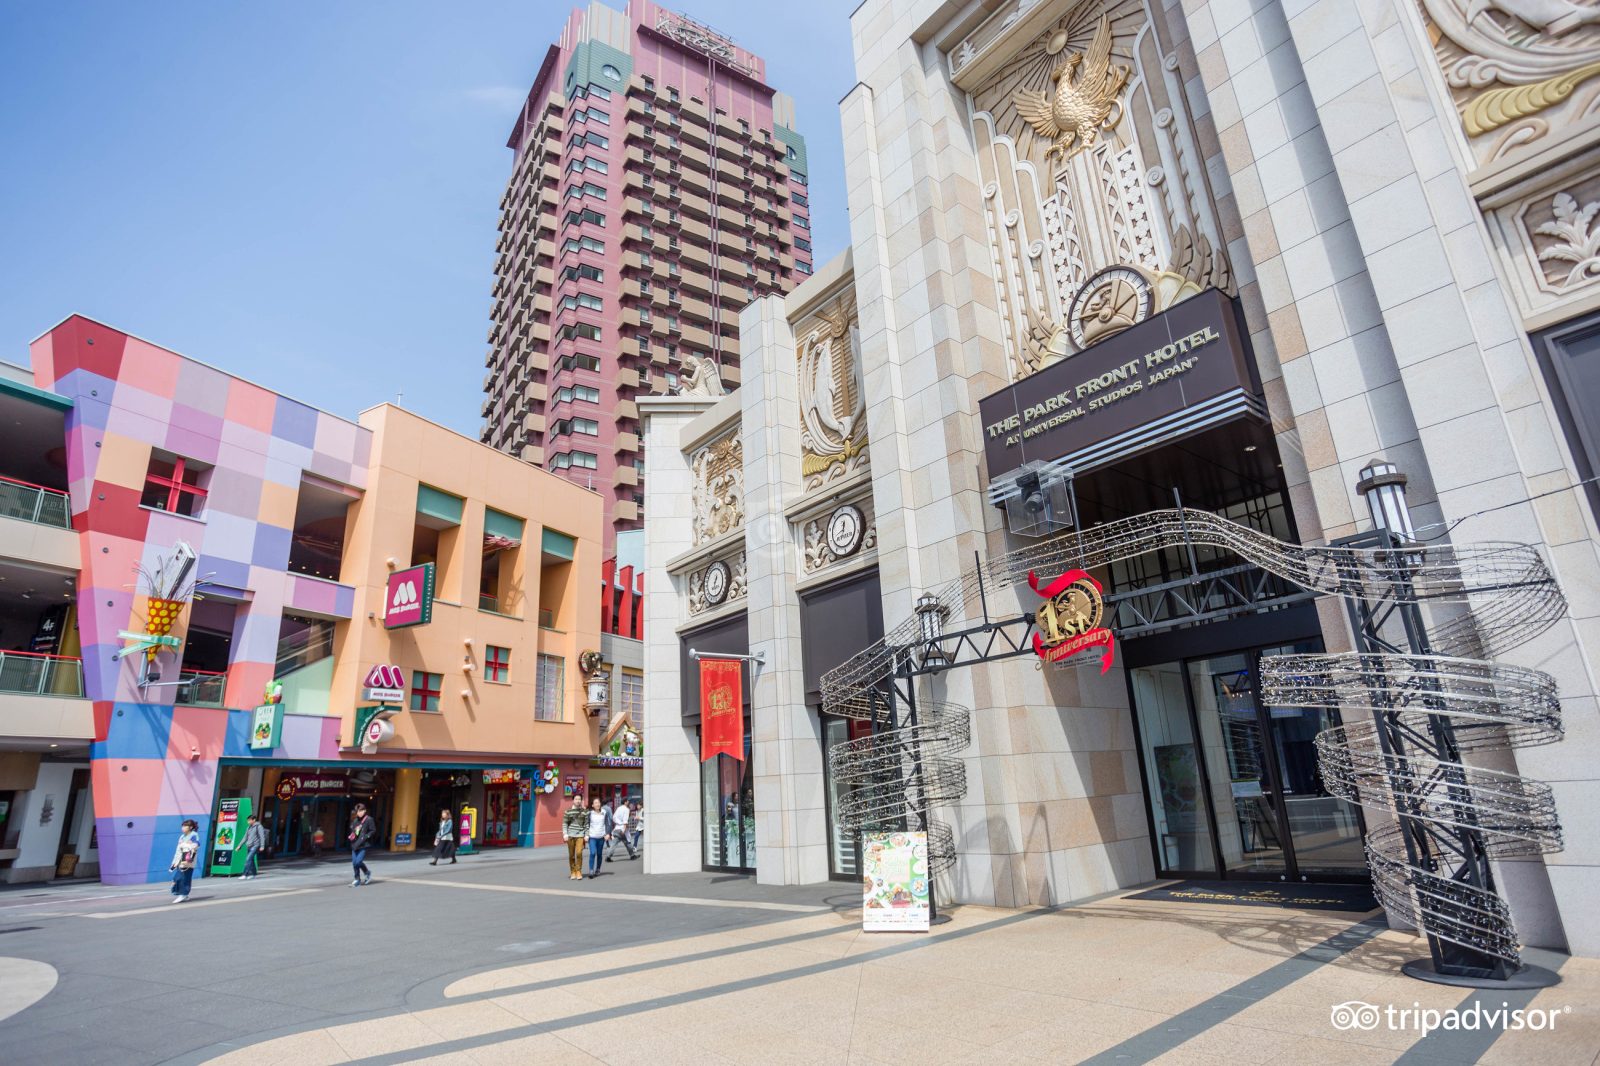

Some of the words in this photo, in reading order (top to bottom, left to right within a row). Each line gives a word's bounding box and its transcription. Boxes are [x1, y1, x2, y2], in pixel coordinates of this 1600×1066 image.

[987, 413, 1020, 438] THE
[1023, 390, 1072, 423] PARK
[1075, 359, 1140, 400] FRONT
[1144, 326, 1220, 369] HOTEL
[1006, 434, 1020, 447] AT
[1023, 407, 1085, 438] UNIVERSAL
[1089, 380, 1143, 410] STUDIOS
[1040, 602, 1092, 644] 1st
[1041, 629, 1112, 664] Anniversary
[303, 780, 319, 789] MOS
[320, 780, 344, 789] BURGER
